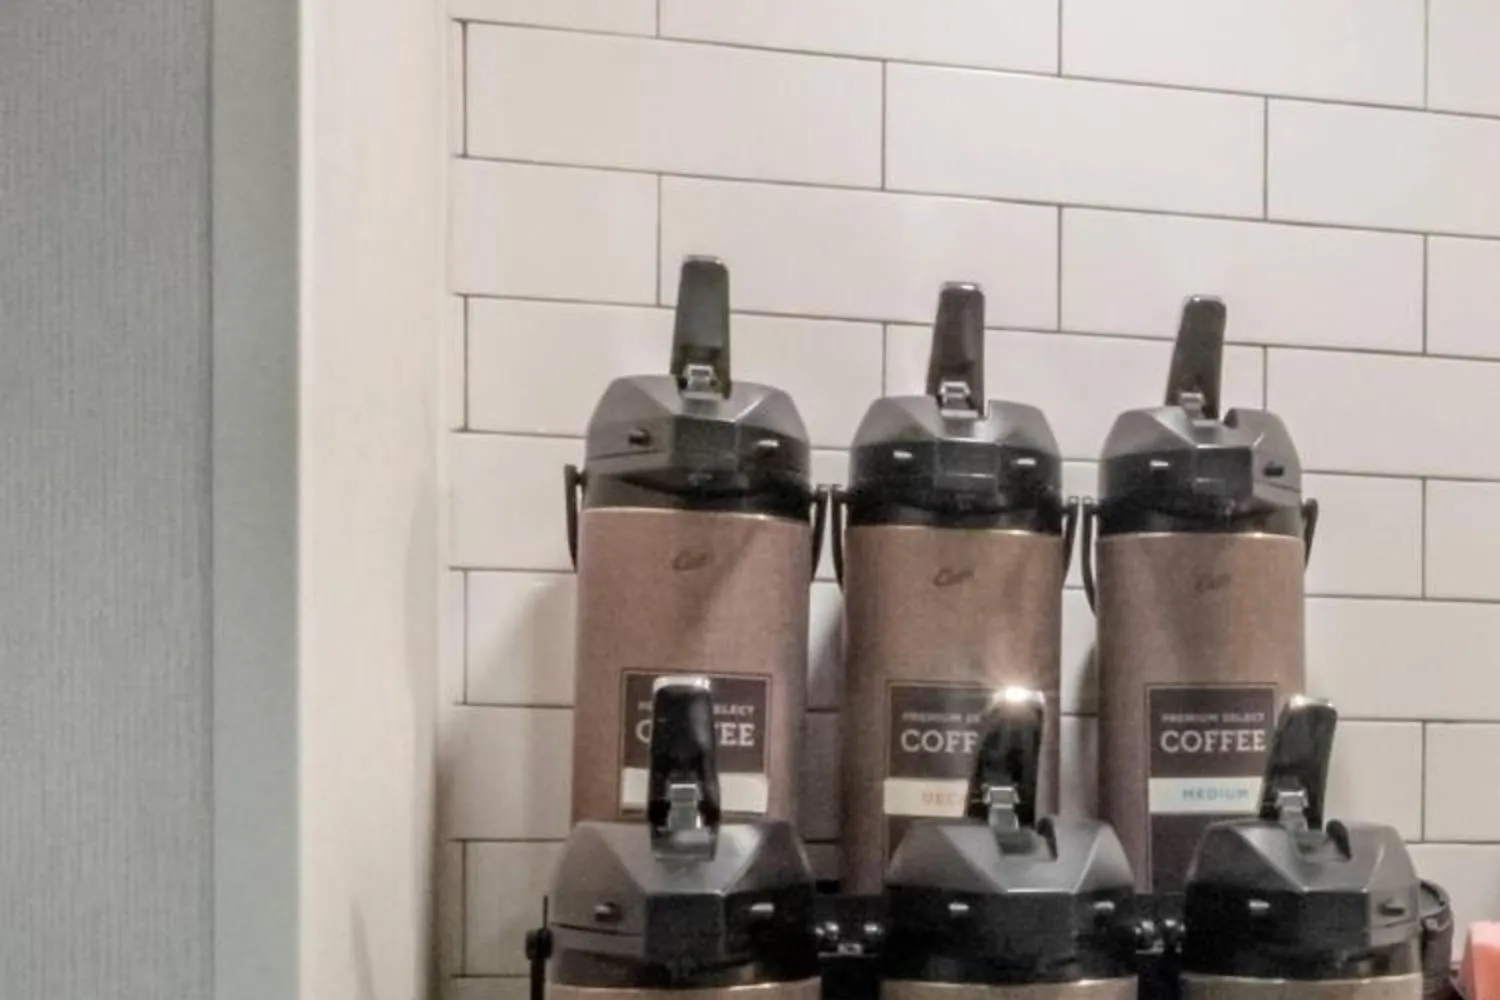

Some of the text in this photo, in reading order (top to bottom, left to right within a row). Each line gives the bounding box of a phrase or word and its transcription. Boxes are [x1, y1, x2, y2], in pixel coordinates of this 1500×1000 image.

[1161, 712, 1266, 724] PREMIUM SELECT
[900, 728, 980, 754] COFF
[1160, 728, 1267, 754] COFFEE
[1181, 787, 1249, 801] MEDIUM
